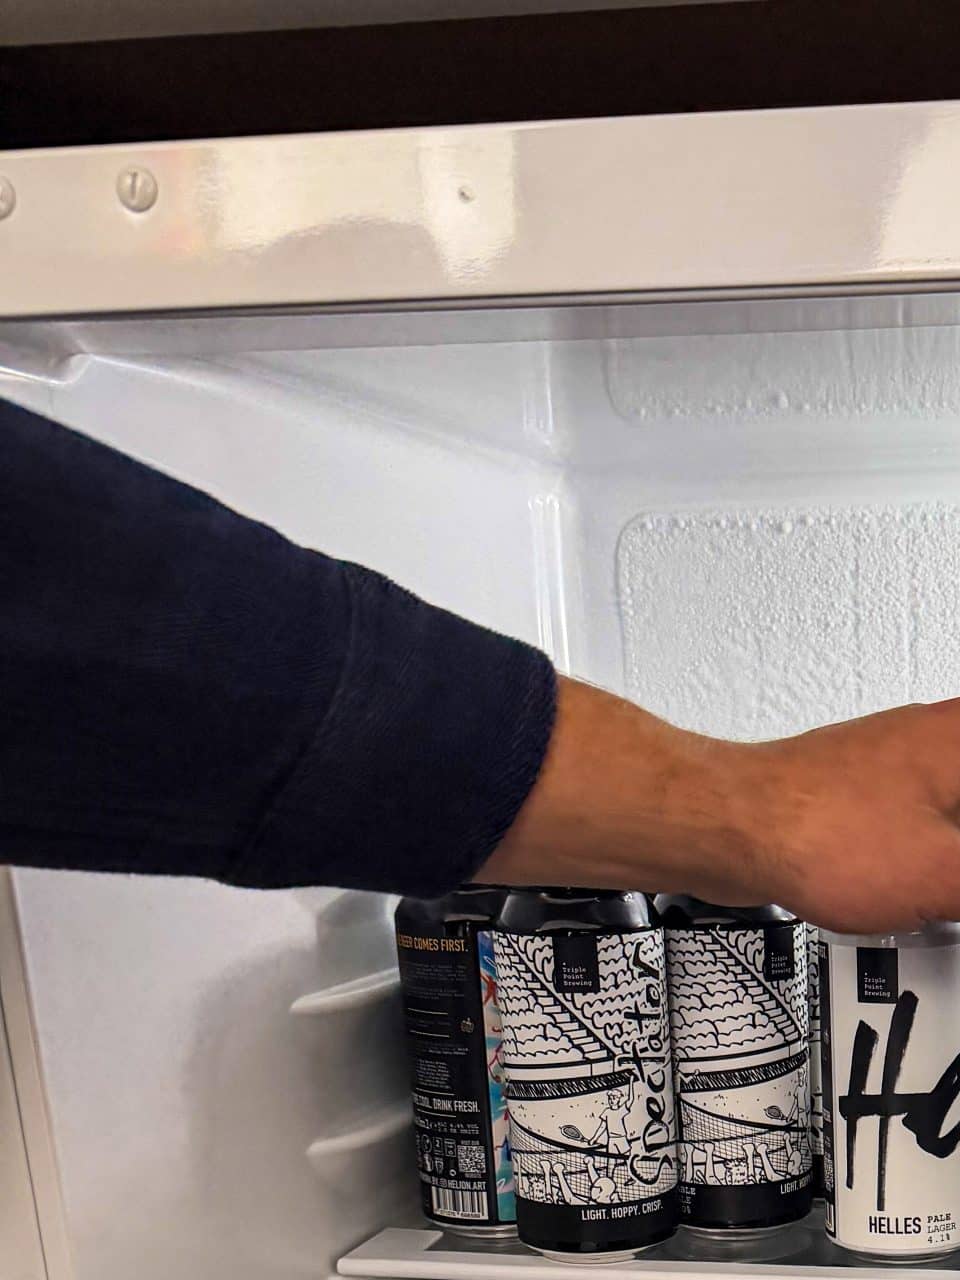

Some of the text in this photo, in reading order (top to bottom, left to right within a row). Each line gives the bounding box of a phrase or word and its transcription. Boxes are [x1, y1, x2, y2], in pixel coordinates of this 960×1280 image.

[414, 937, 439, 951] COMES
[441, 938, 469, 952] FIRST.
[562, 966, 587, 974] Triple
[454, 1100, 481, 1113] FRESH.
[581, 1200, 664, 1221] LIGHT. HOPPY. CRISP.
[926, 1213, 952, 1223] PALE
[868, 1215, 922, 1235] HELLES
[926, 1222, 957, 1233] LAGER
